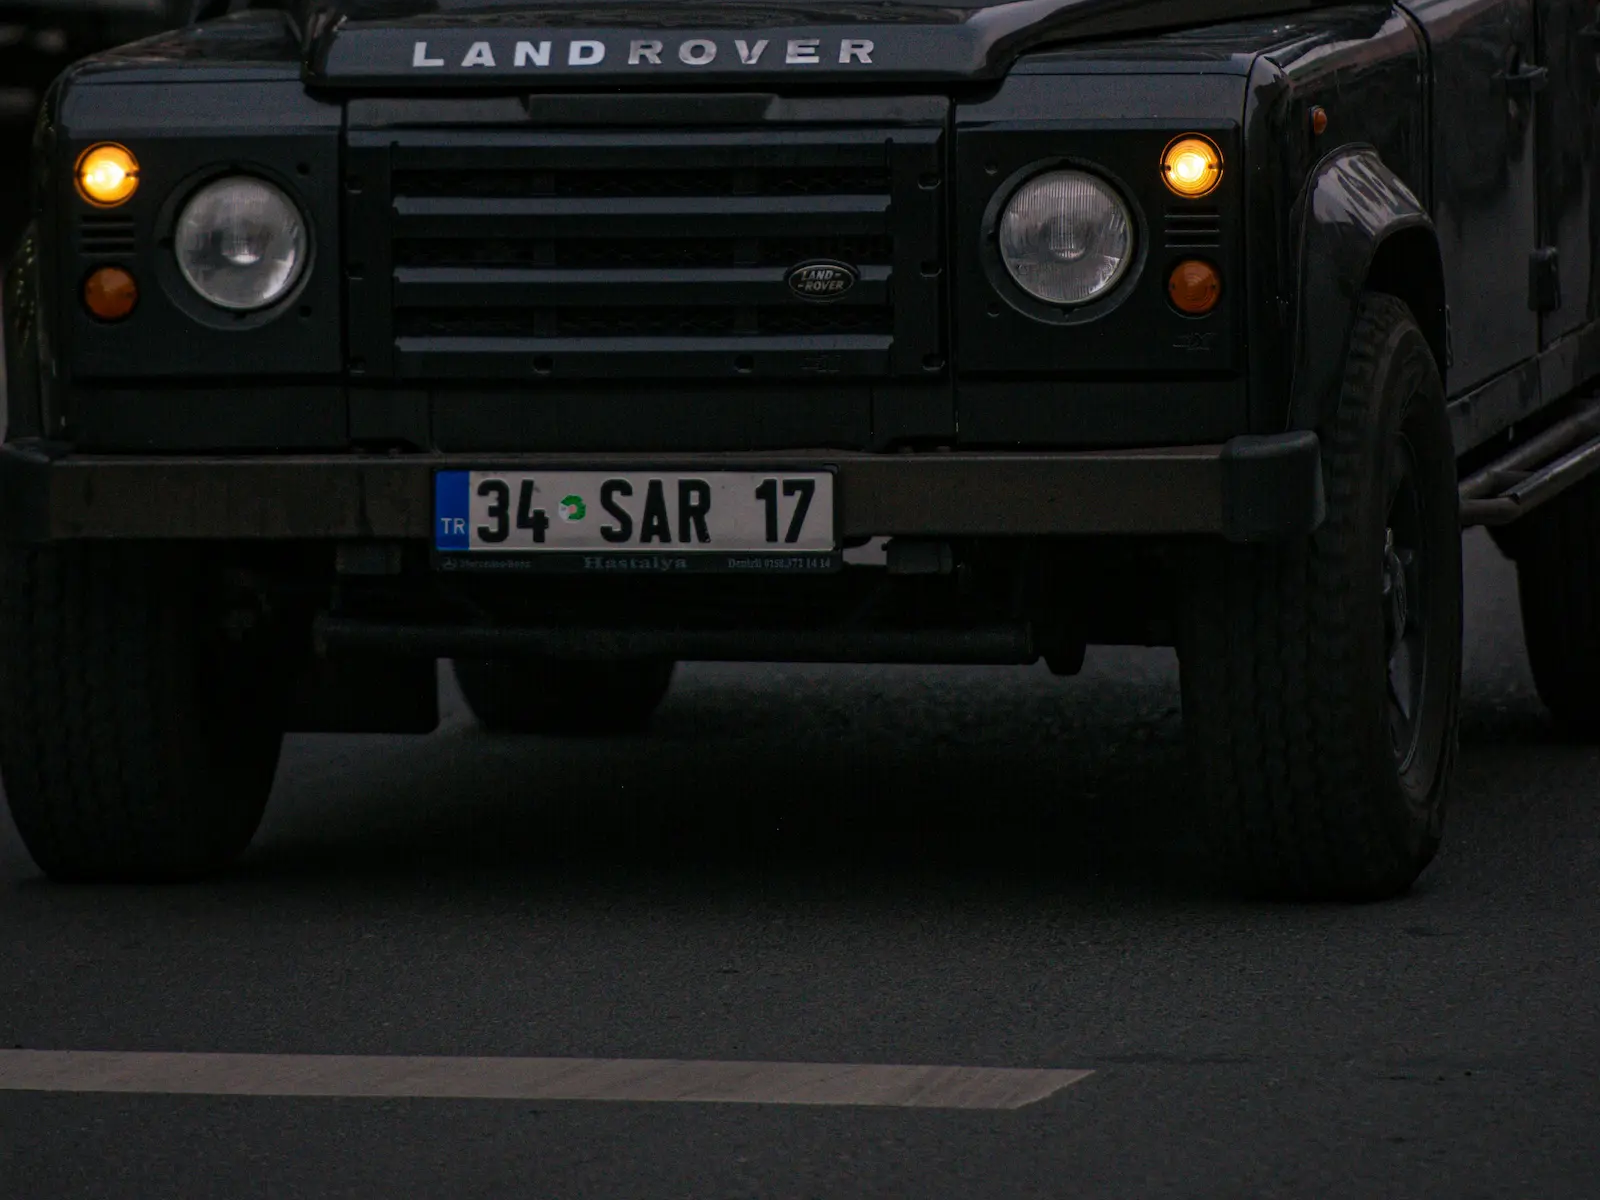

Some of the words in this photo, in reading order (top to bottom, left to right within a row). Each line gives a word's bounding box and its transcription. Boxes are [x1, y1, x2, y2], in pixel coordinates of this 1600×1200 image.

[412, 40, 606, 67] LAND
[627, 38, 875, 65] ROVER
[476, 478, 550, 544] 34
[600, 478, 712, 544] SAR
[754, 478, 816, 544] 17
[441, 517, 466, 535] TR
